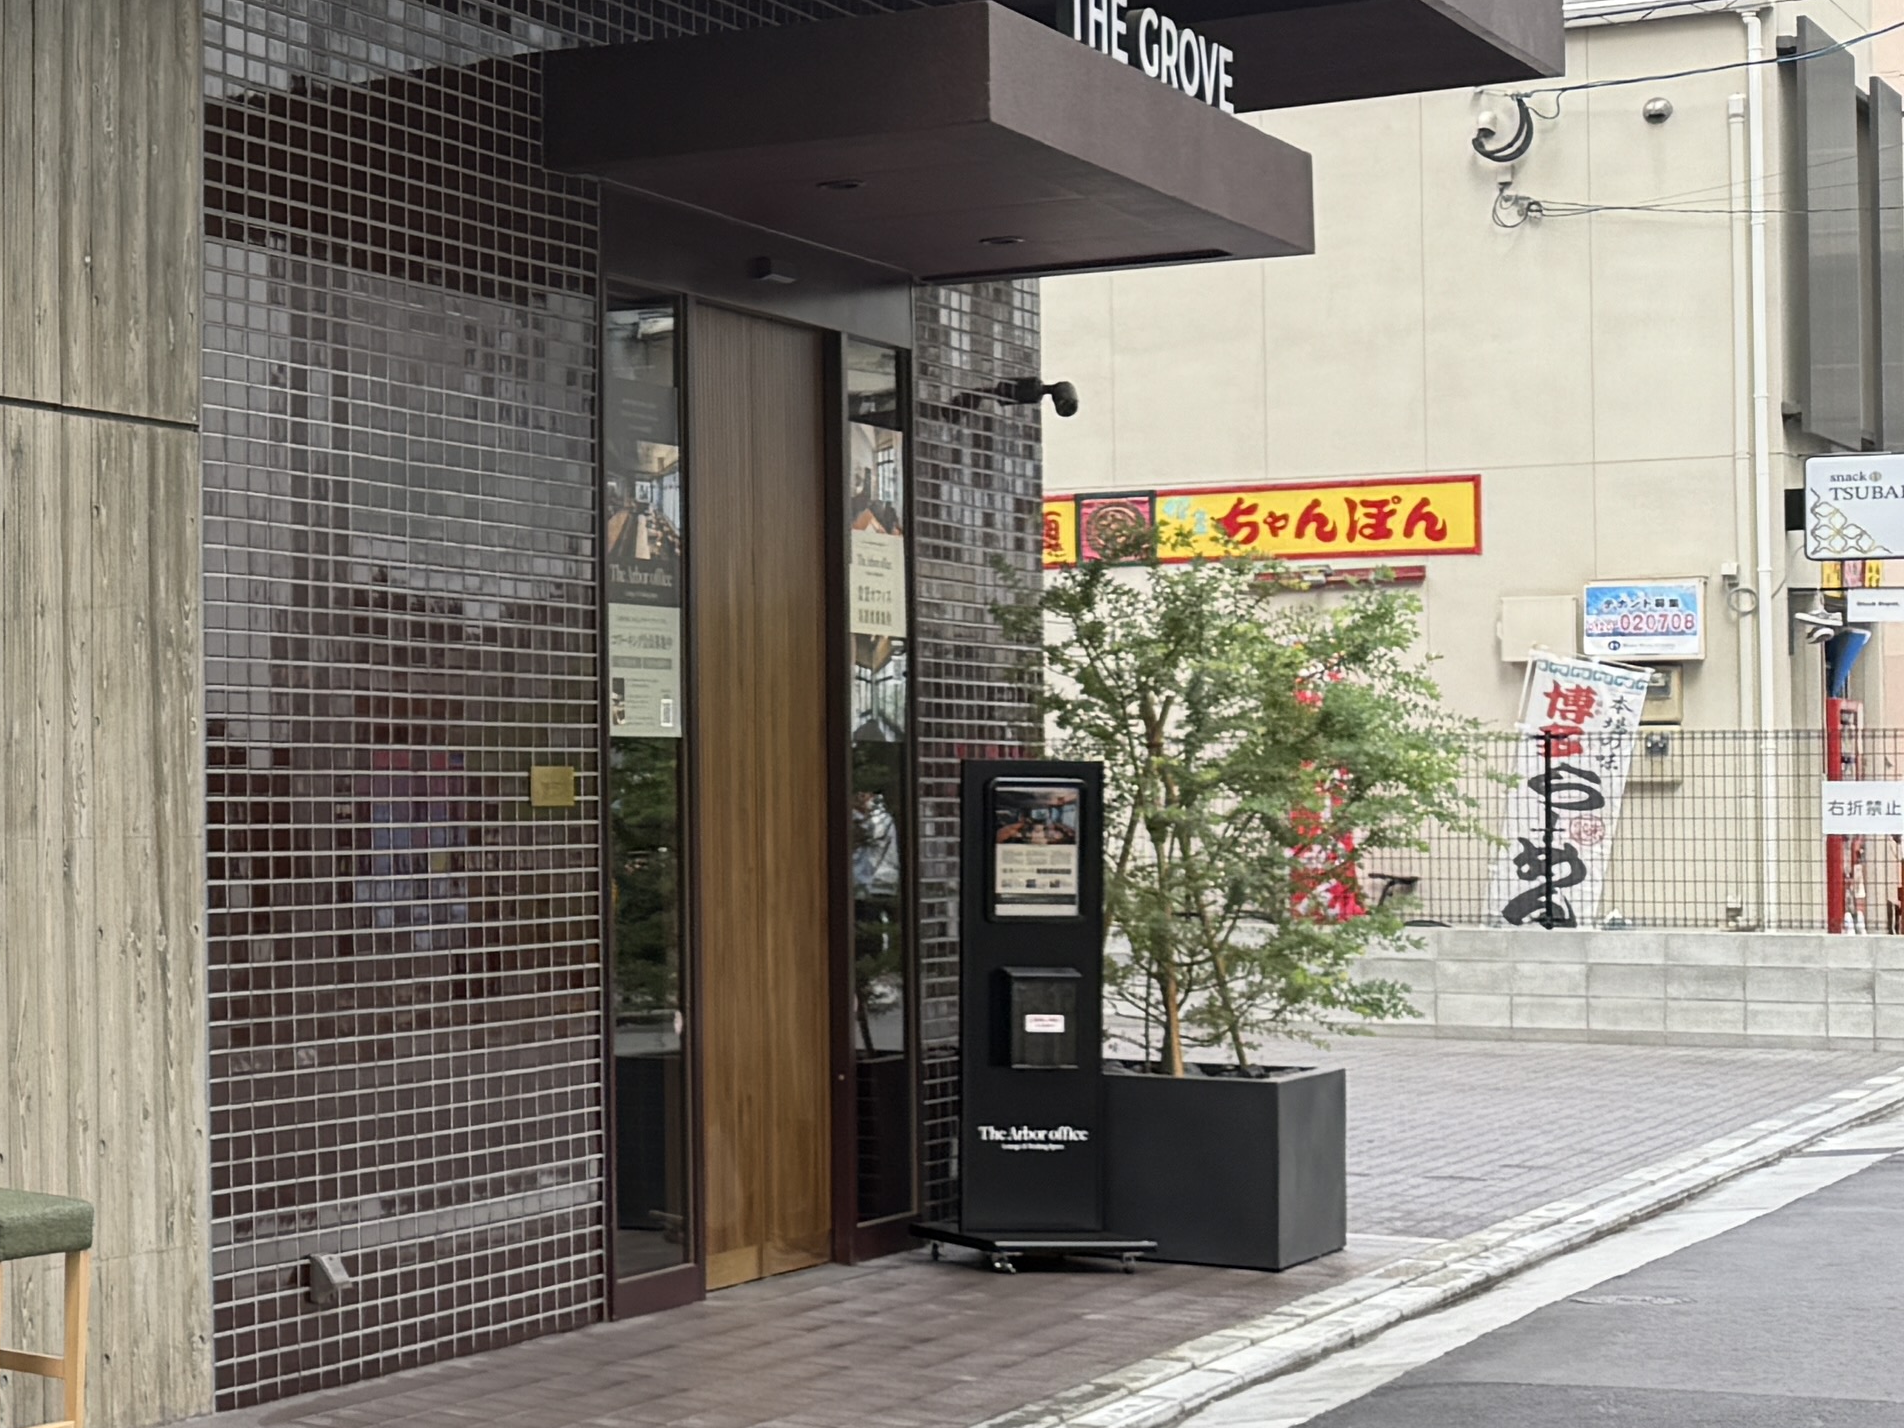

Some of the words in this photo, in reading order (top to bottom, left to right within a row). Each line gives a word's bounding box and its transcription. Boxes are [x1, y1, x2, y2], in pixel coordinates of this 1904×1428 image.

[1139, 7, 1235, 115] GROVE
[1829, 471, 1867, 483] snack
[1219, 495, 1449, 546] ちゃんぽん
[1621, 613, 1695, 632] 020708
[1595, 694, 1633, 771] 本場の味
[1827, 799, 1903, 816] 右折禁止
[977, 1125, 1007, 1141] The
[1007, 1125, 1048, 1141] Arbor
[1048, 1125, 1089, 1141] office
